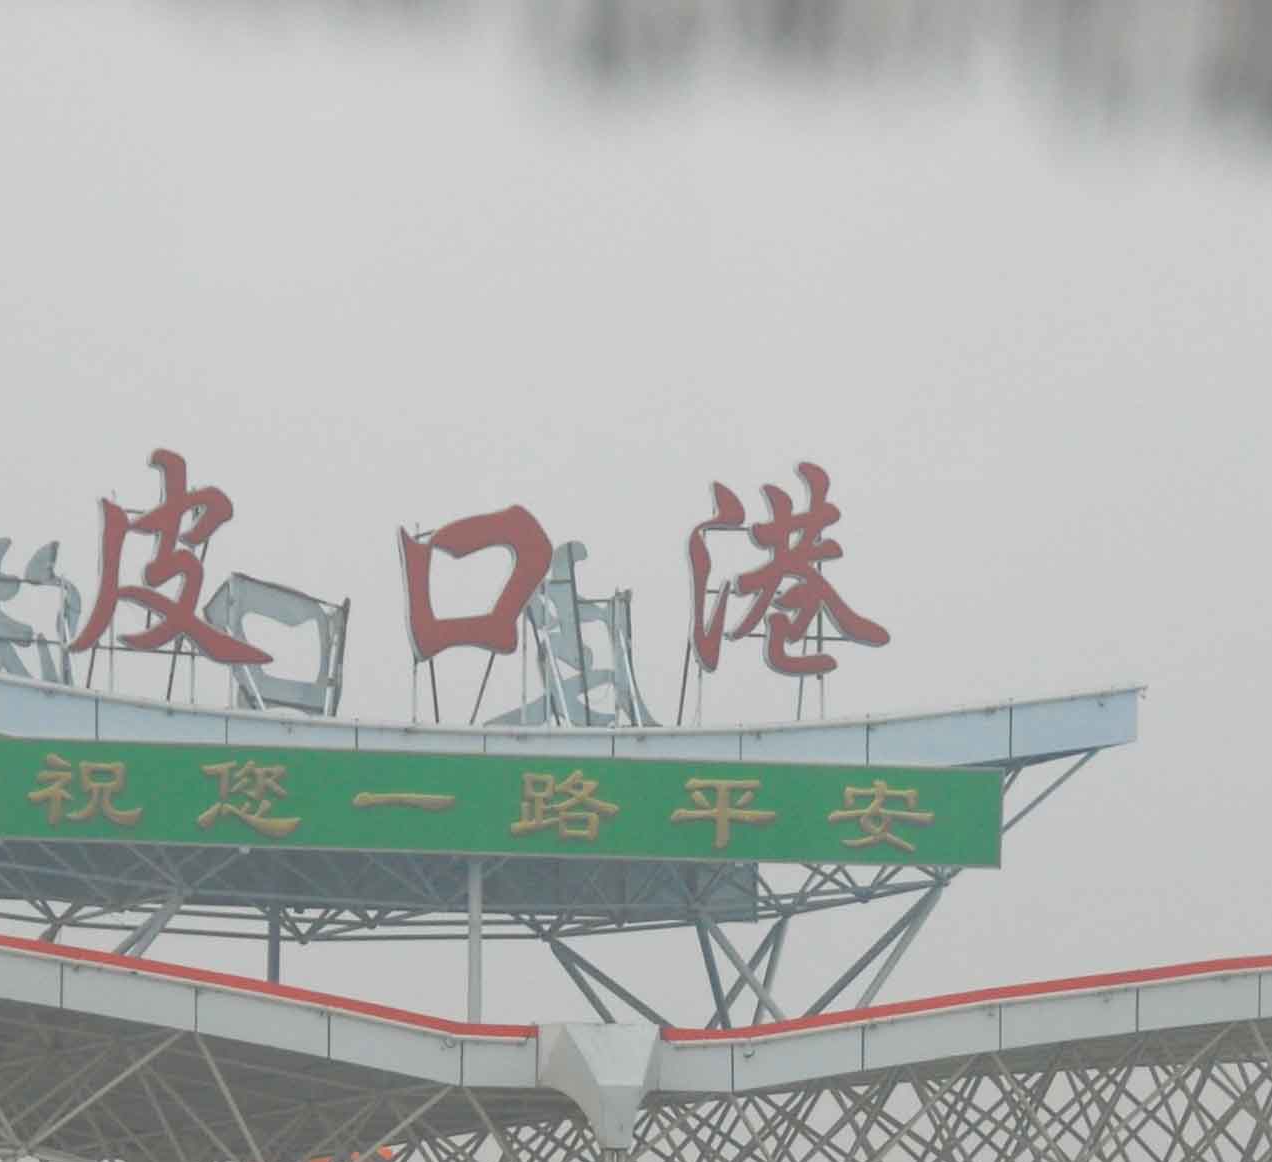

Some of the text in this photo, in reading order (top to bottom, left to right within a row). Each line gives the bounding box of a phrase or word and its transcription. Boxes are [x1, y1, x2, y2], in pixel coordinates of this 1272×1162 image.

[68, 447, 891, 677] 皮口港
[28, 752, 936, 853] 祝您一路平安
